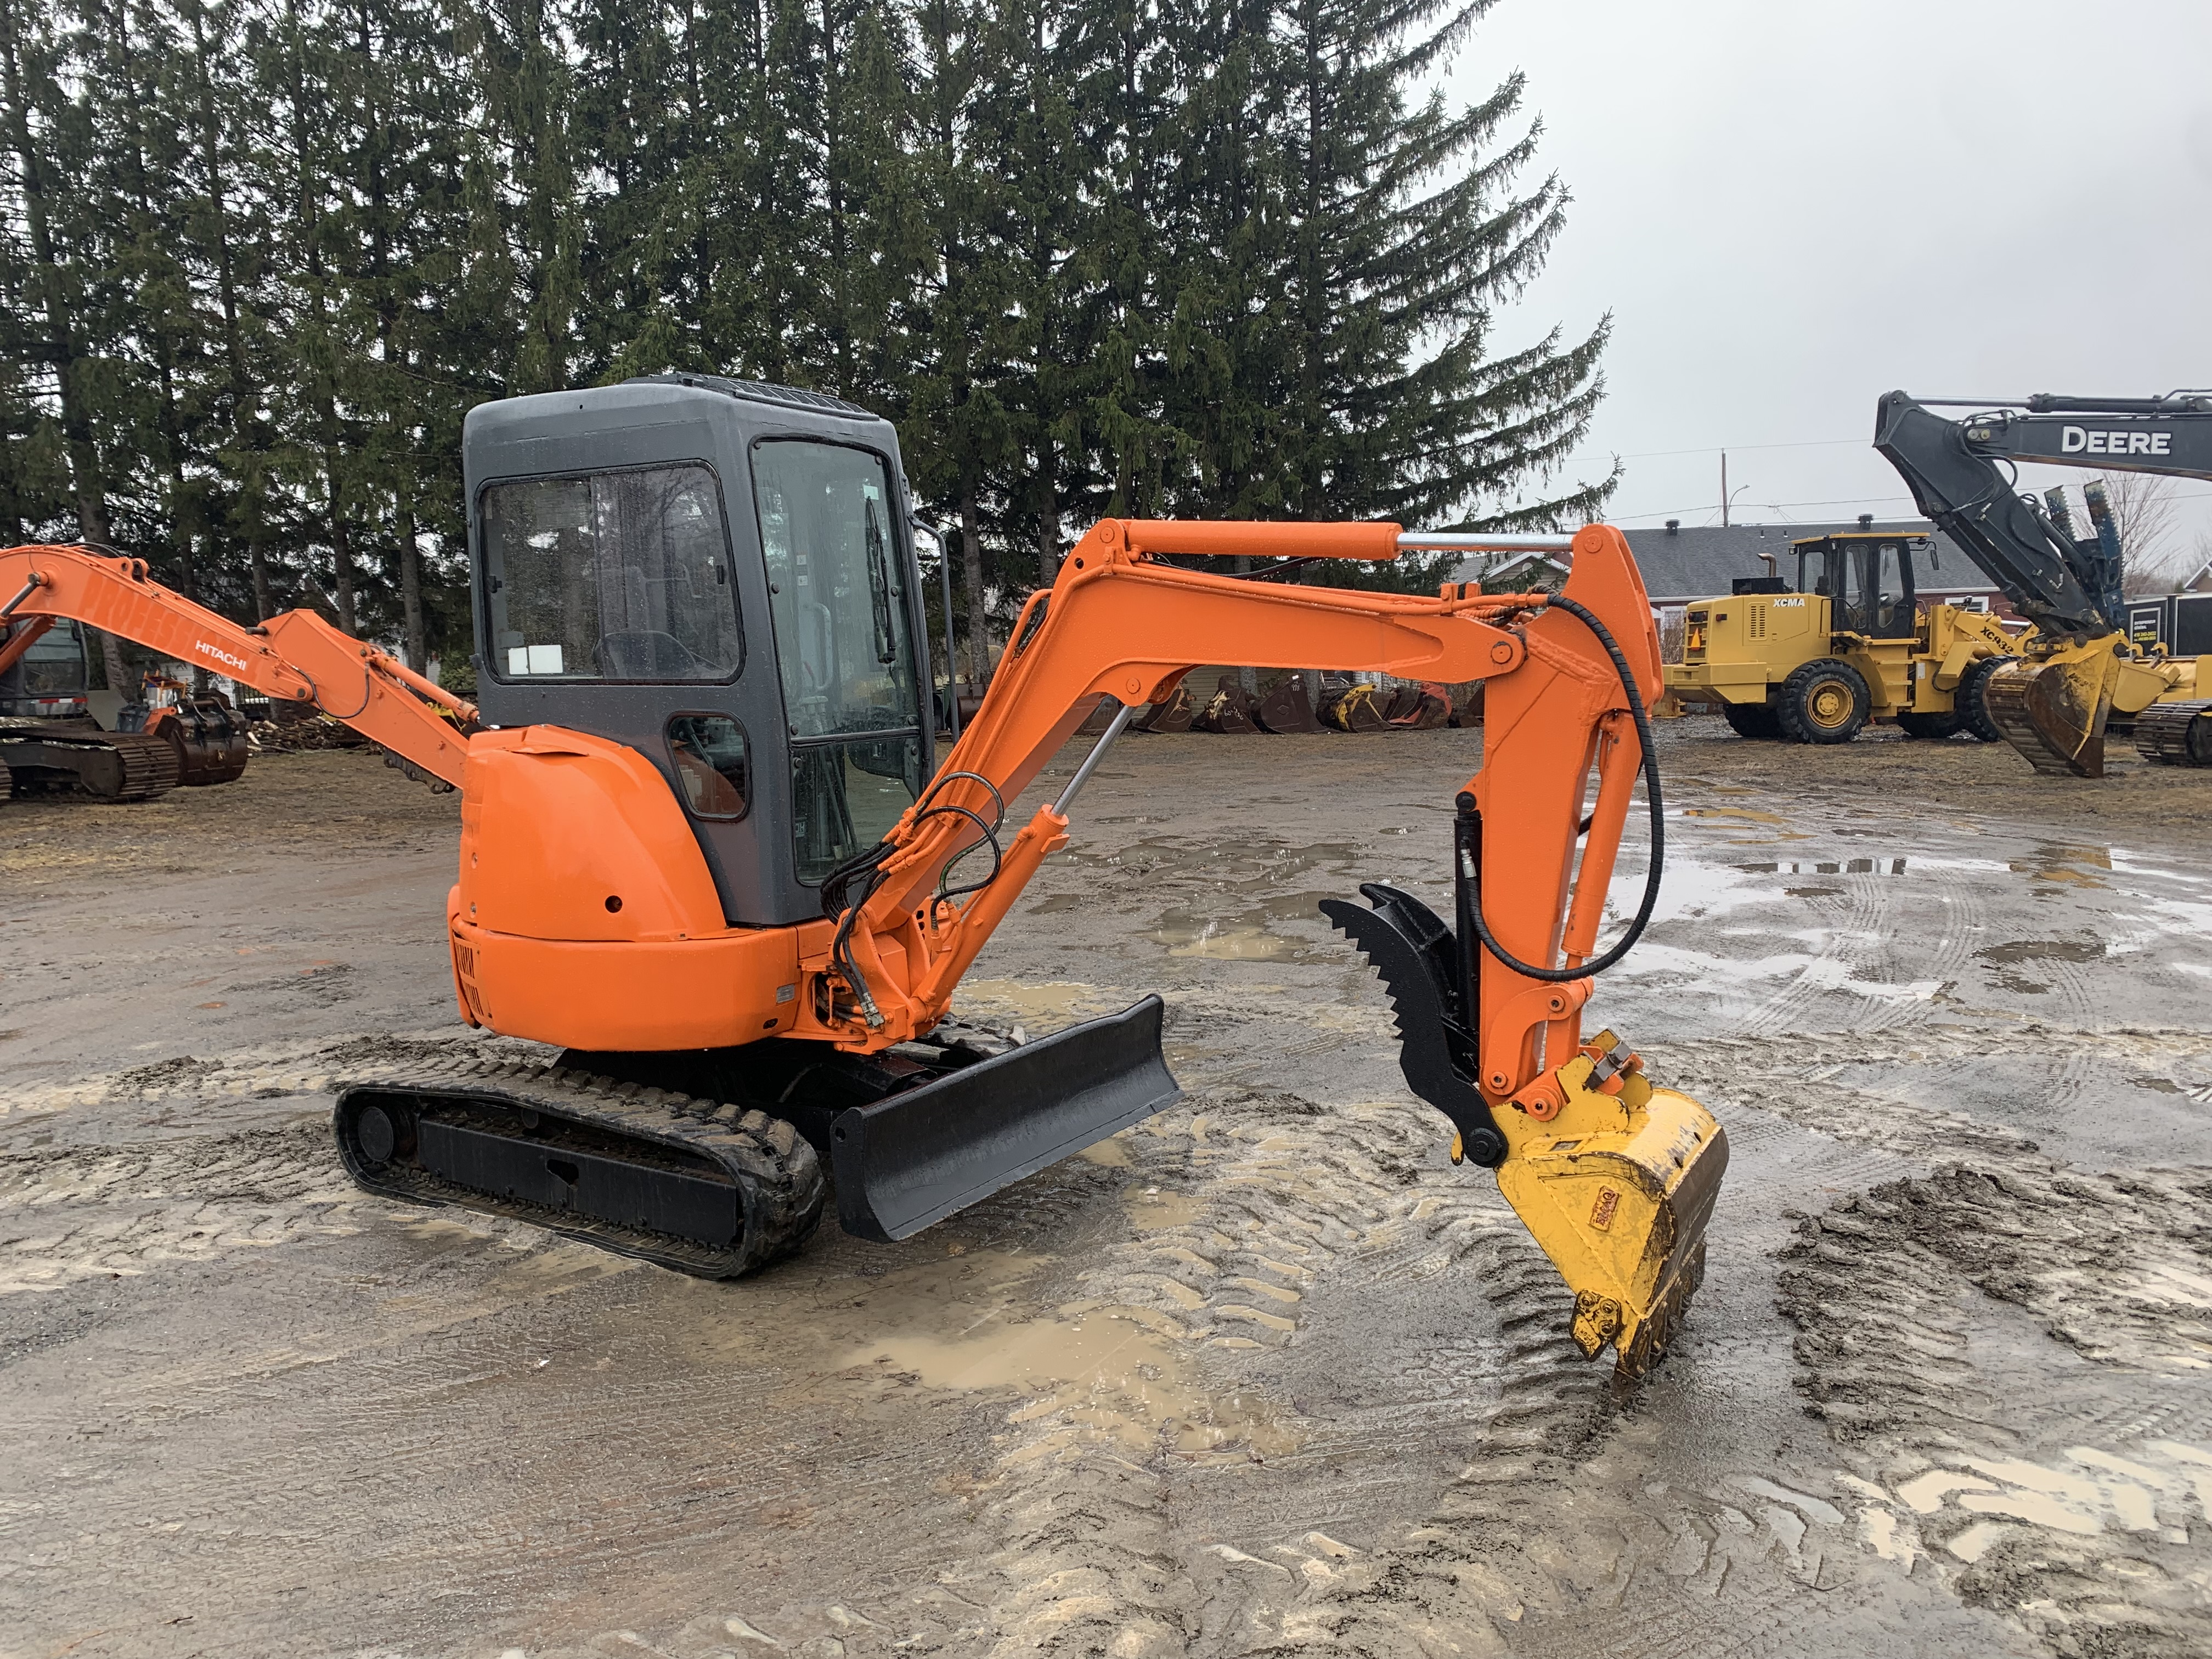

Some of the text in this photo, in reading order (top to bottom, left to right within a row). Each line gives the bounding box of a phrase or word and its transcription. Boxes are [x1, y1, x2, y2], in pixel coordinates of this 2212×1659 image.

[2062, 426, 2171, 454] DEERE
[1773, 598, 1805, 607] XCMA
[195, 640, 246, 671] HITACHI
